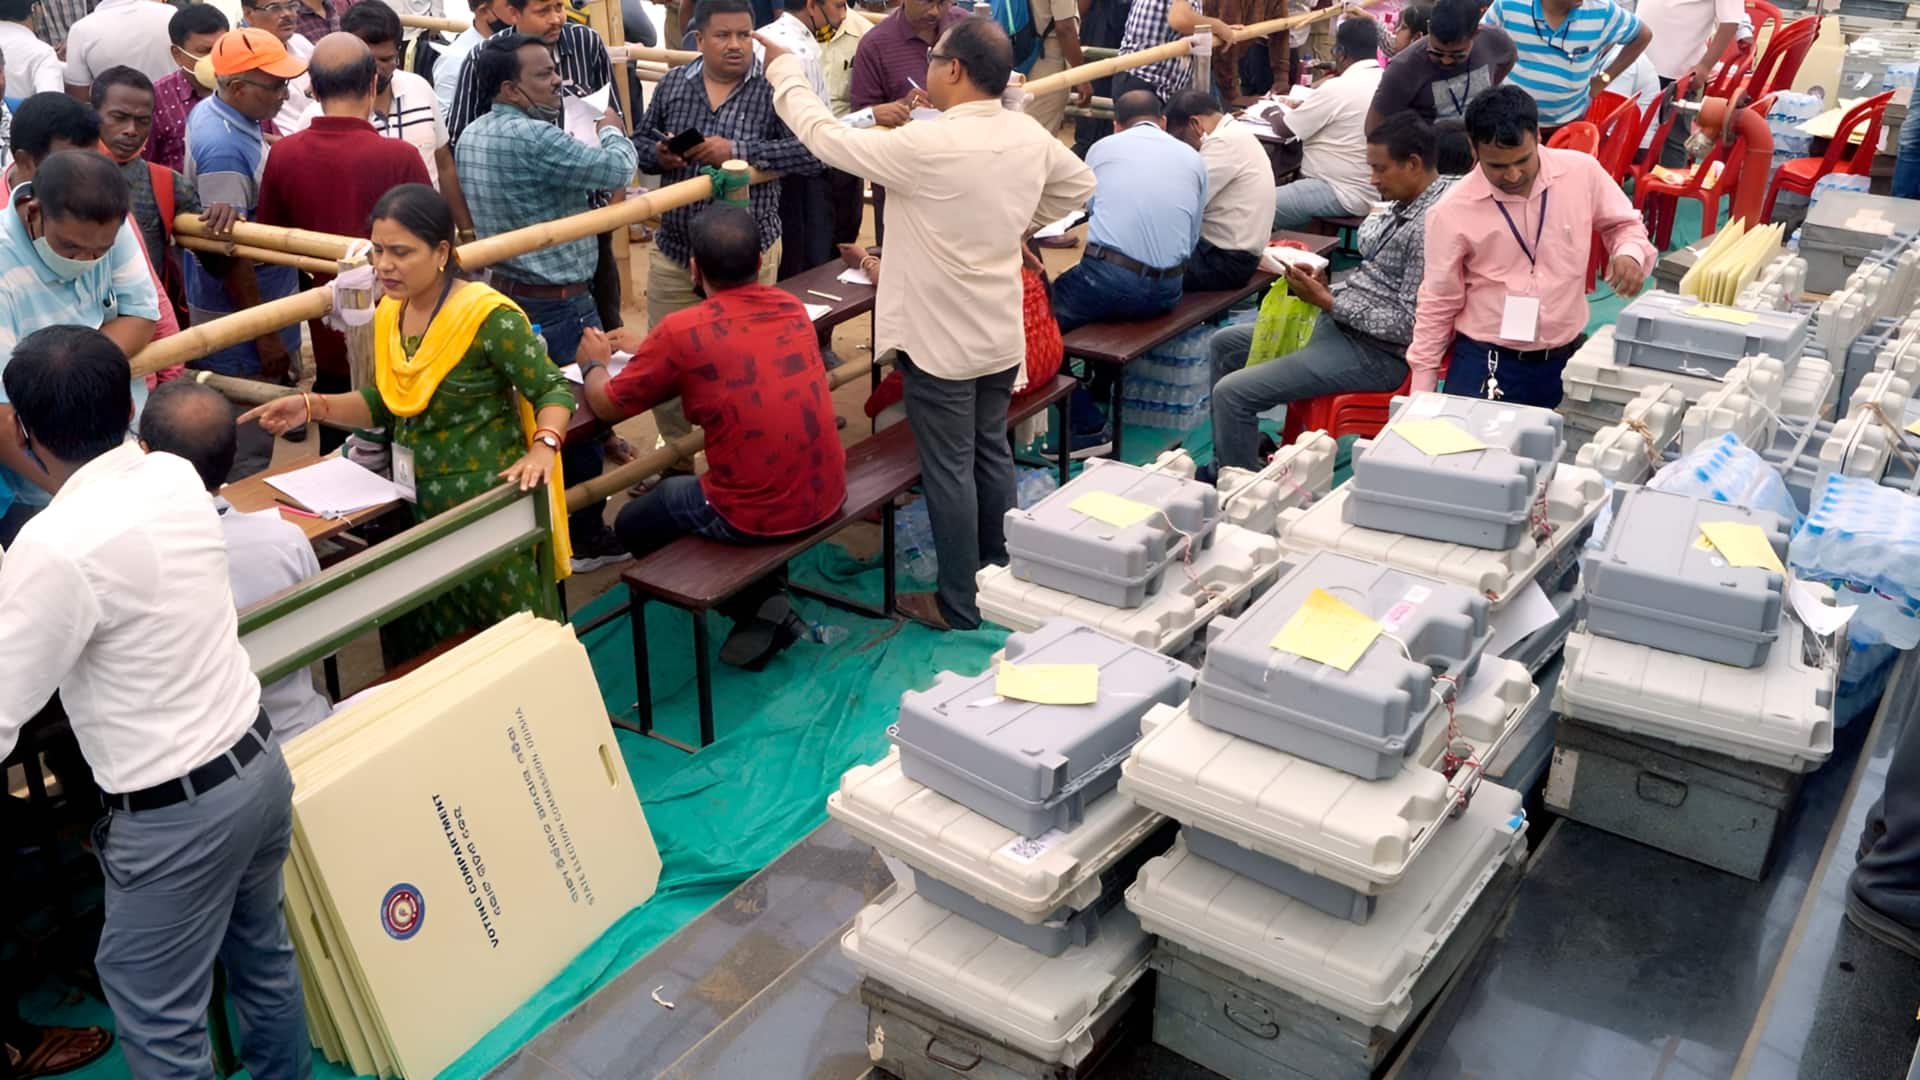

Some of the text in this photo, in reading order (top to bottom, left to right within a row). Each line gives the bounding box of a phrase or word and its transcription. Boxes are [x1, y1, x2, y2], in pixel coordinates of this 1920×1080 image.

[432, 793, 499, 948] VOTING COMPARTMENT
[578, 872, 594, 906] STATE
